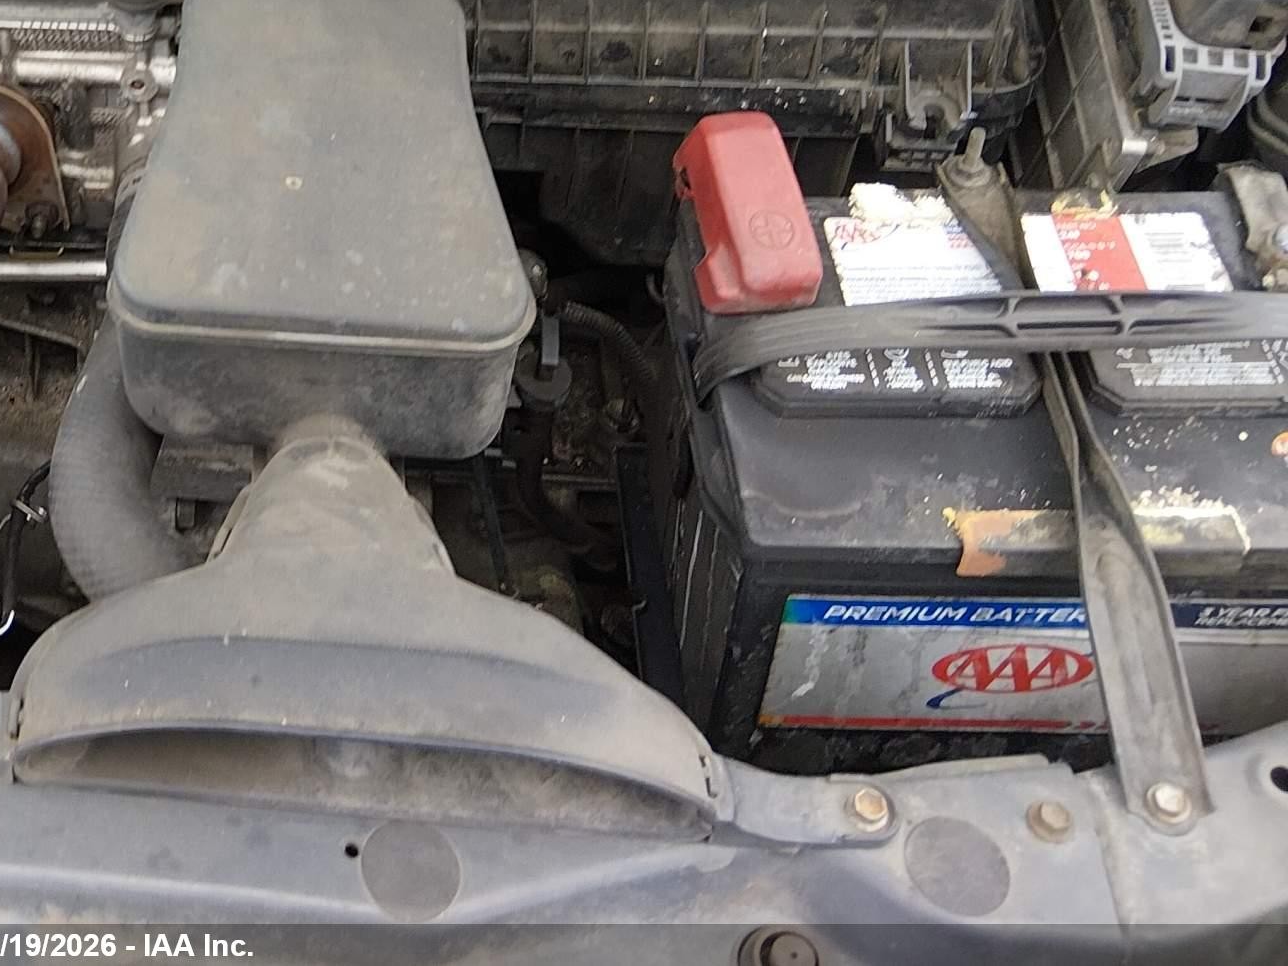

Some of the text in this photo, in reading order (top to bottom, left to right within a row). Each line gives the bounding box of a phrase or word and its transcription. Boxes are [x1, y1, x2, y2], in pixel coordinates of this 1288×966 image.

[823, 604, 1087, 624] PREMIUM BATTER
[938, 644, 1088, 692] AAA
